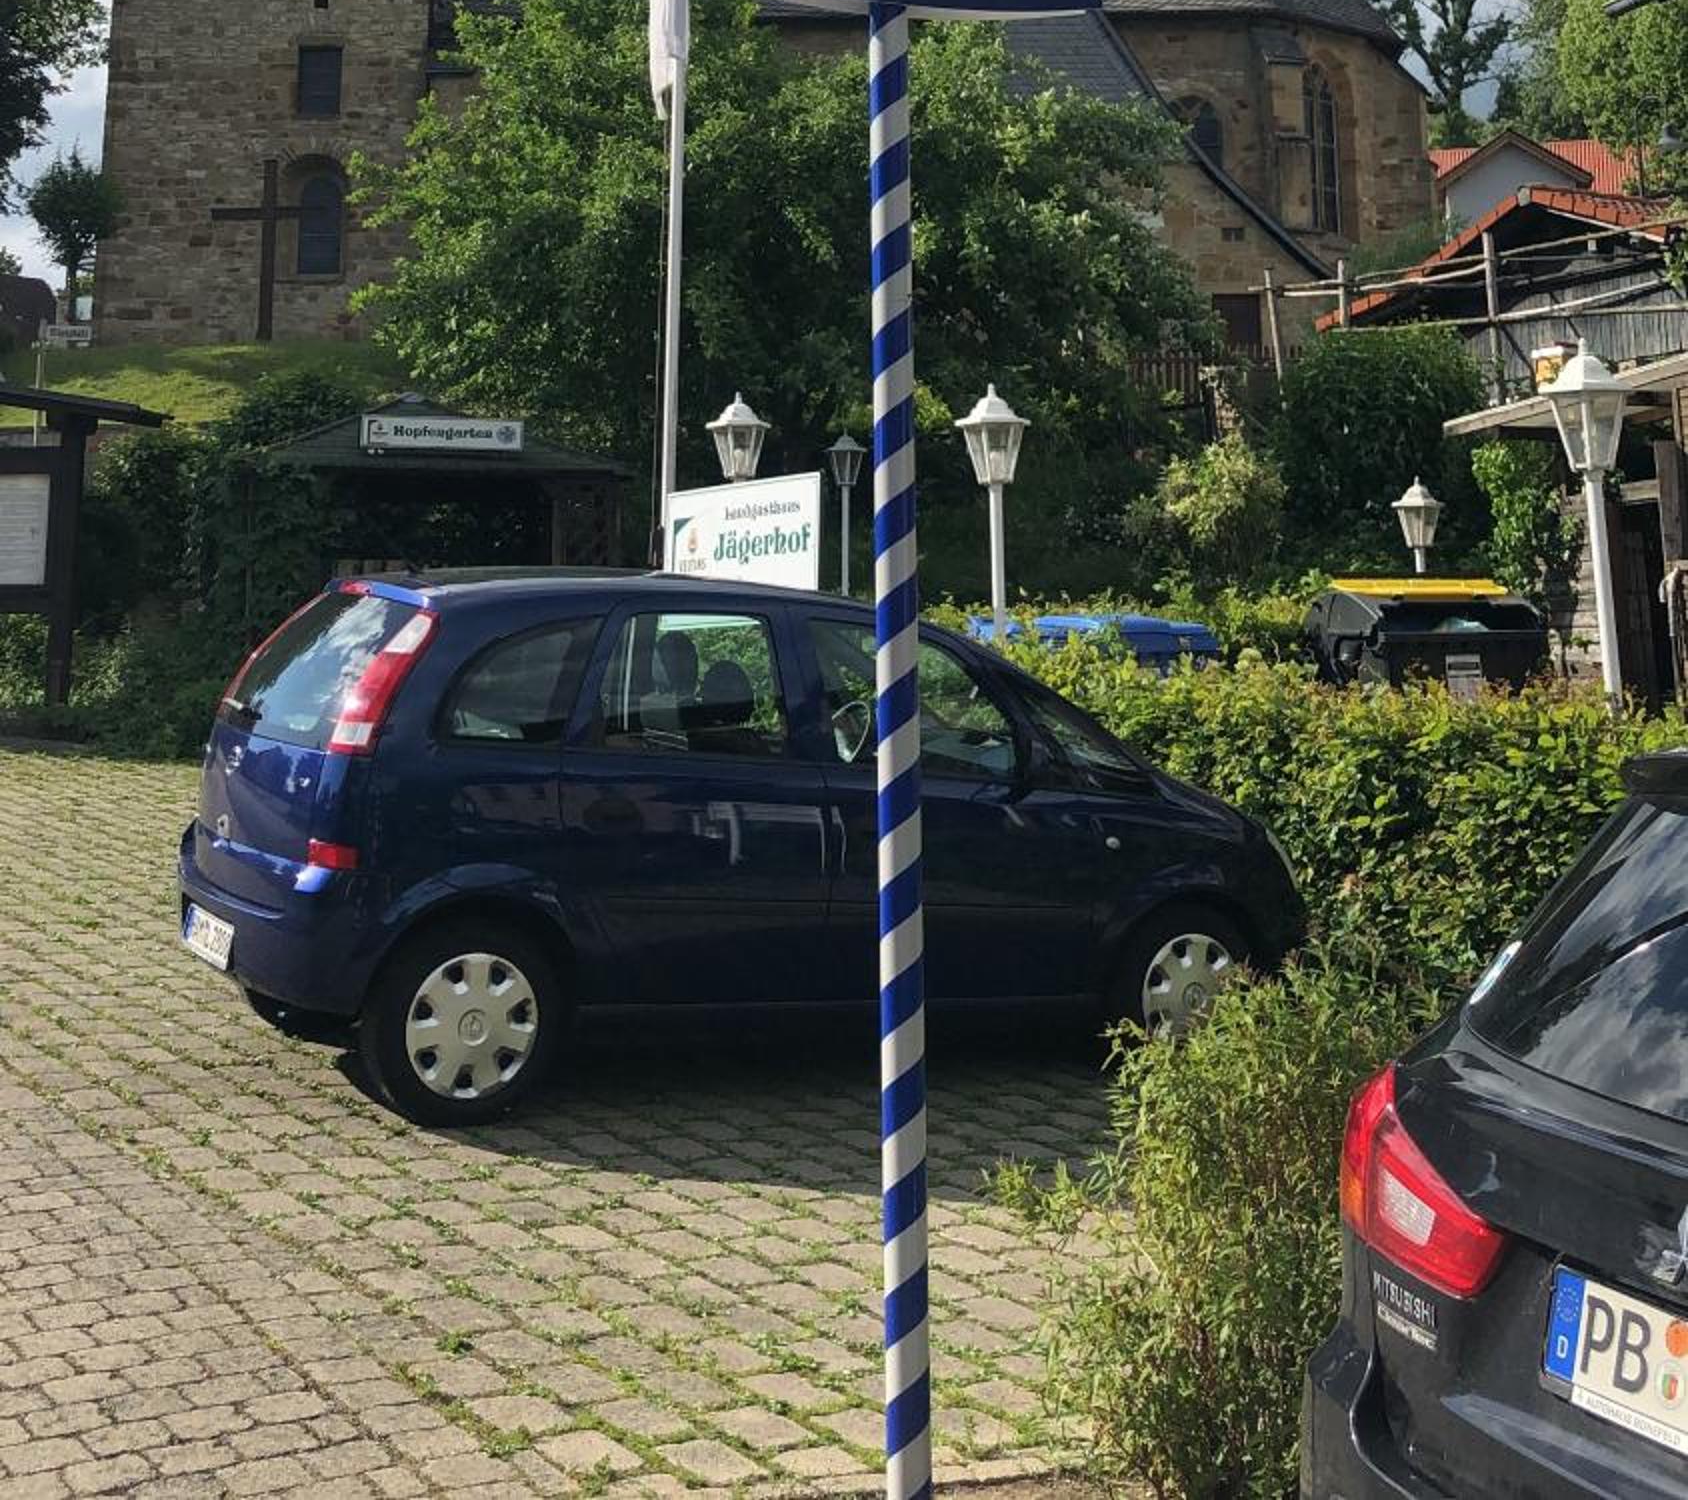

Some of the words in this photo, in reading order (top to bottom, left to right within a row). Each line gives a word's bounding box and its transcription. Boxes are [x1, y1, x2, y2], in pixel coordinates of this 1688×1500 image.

[393, 425, 493, 441] Hopfengarten
[714, 523, 811, 565] Jägerhof
[1373, 1271, 1436, 1328] MITSUBISHI
[1555, 1335, 1568, 1360] D
[1580, 1294, 1652, 1393] PB
